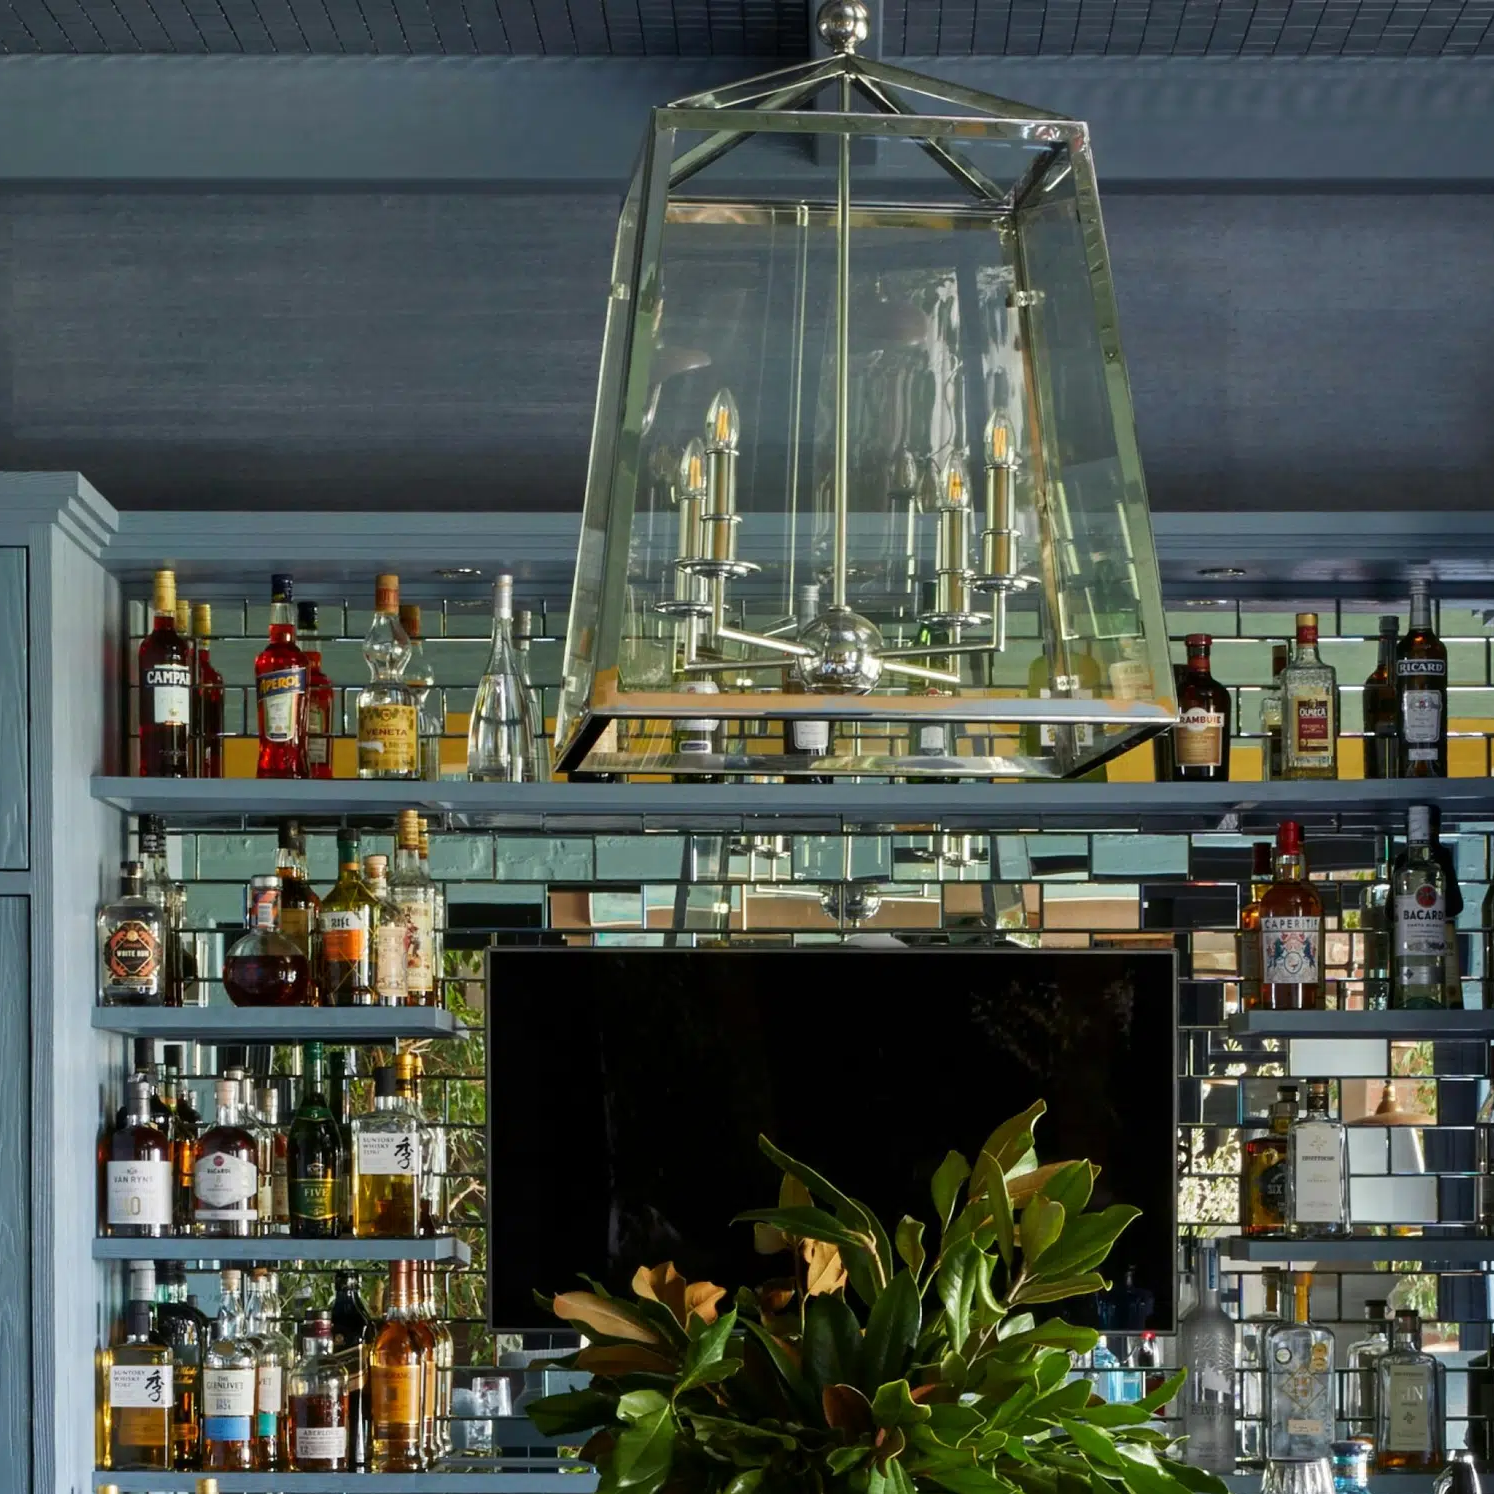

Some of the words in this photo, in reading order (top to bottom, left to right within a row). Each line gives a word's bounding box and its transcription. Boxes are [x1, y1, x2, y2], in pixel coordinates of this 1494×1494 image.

[1399, 663, 1443, 672] RICARD
[146, 670, 191, 686] CAMPAR
[259, 674, 301, 695] APEROL
[1299, 707, 1327, 717] OLMECA
[1179, 716, 1222, 724] RAMBUIE
[366, 727, 408, 736] VENETA
[1403, 910, 1445, 921] BACARD
[1264, 918, 1318, 930] CAPERITIF
[116, 949, 136, 957] WHITE
[136, 949, 150, 957] RUM
[113, 1175, 129, 1184] VAN
[303, 1187, 331, 1197] FIVE
[1267, 1183, 1283, 1195] SIX
[206, 1381, 244, 1390] GLENLIVET
